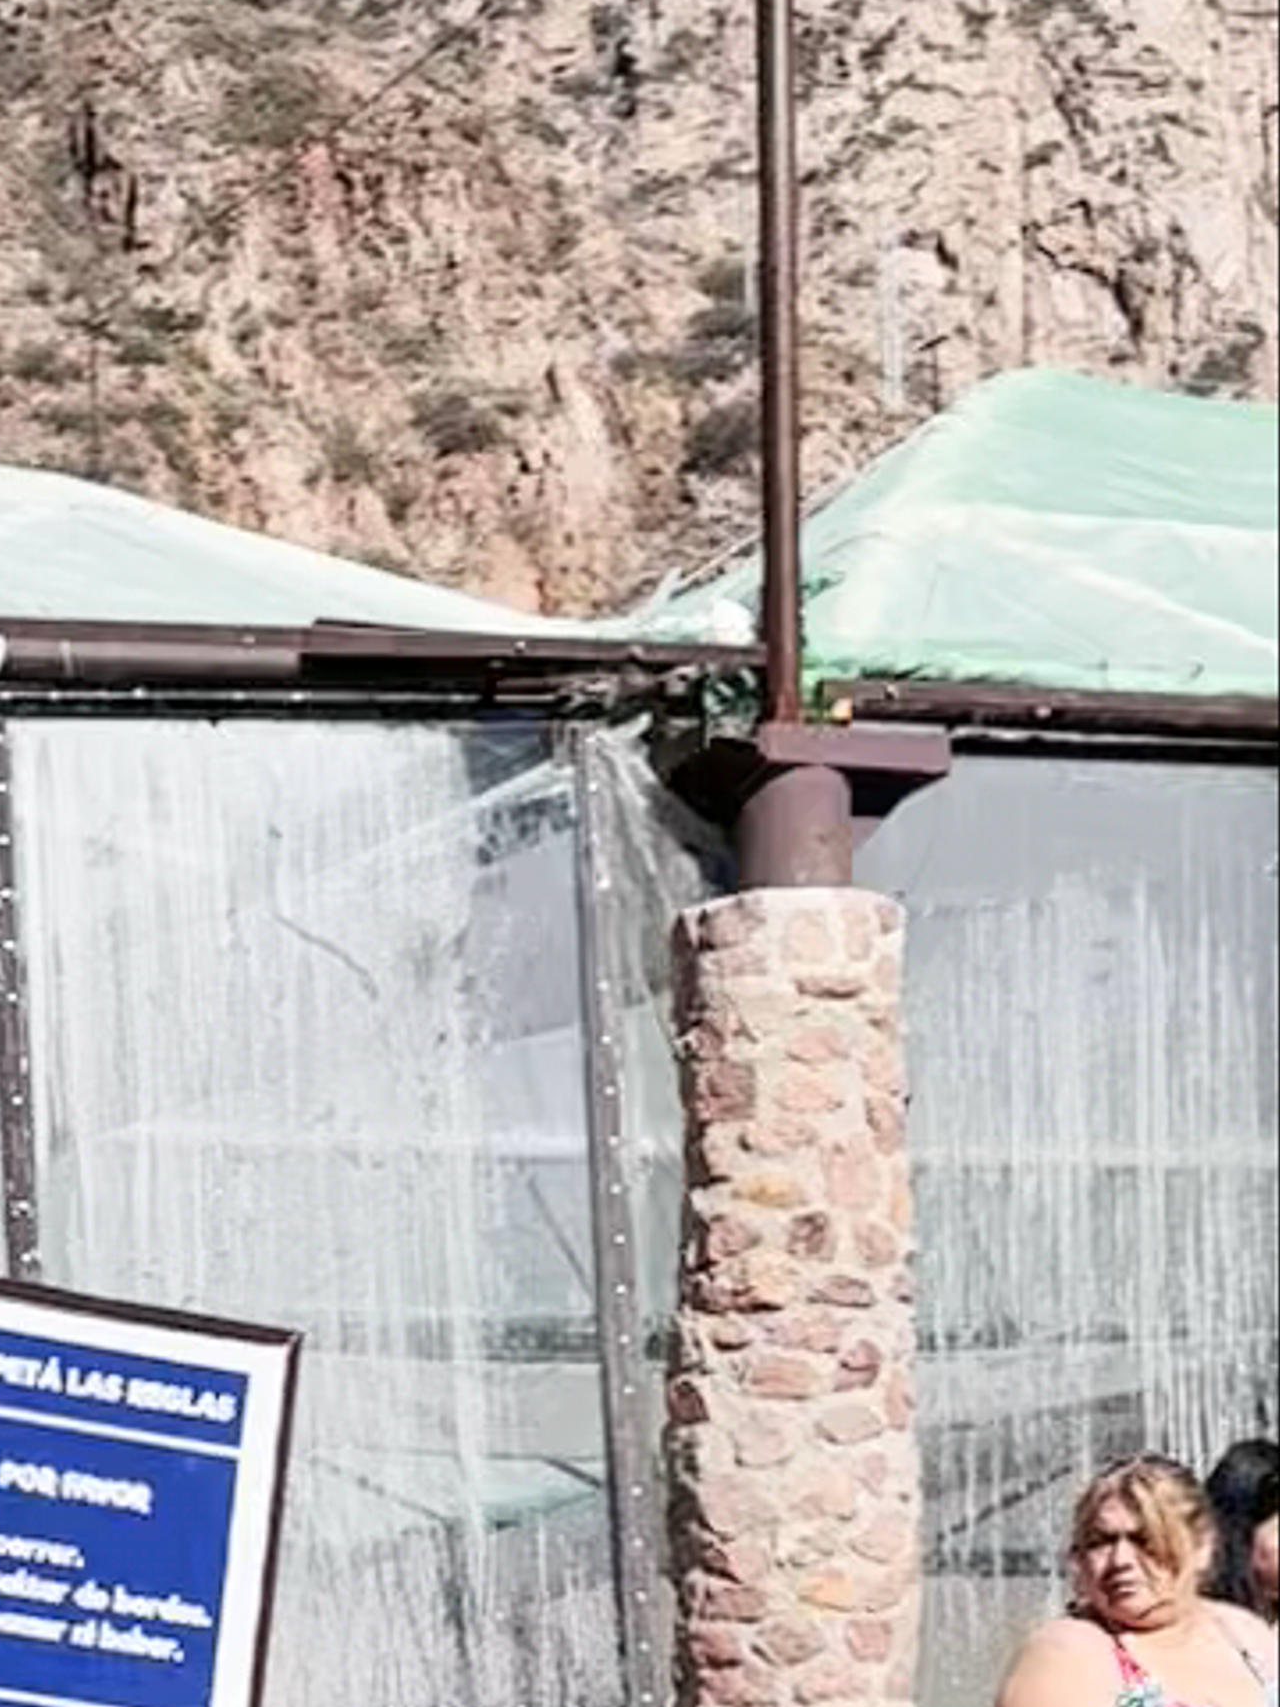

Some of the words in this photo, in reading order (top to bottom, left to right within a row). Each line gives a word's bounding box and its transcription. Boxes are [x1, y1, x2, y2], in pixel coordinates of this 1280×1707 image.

[66, 1367, 123, 1403] LAS
[126, 1378, 237, 1422] REGLAS
[62, 1470, 153, 1514] FAVOR
